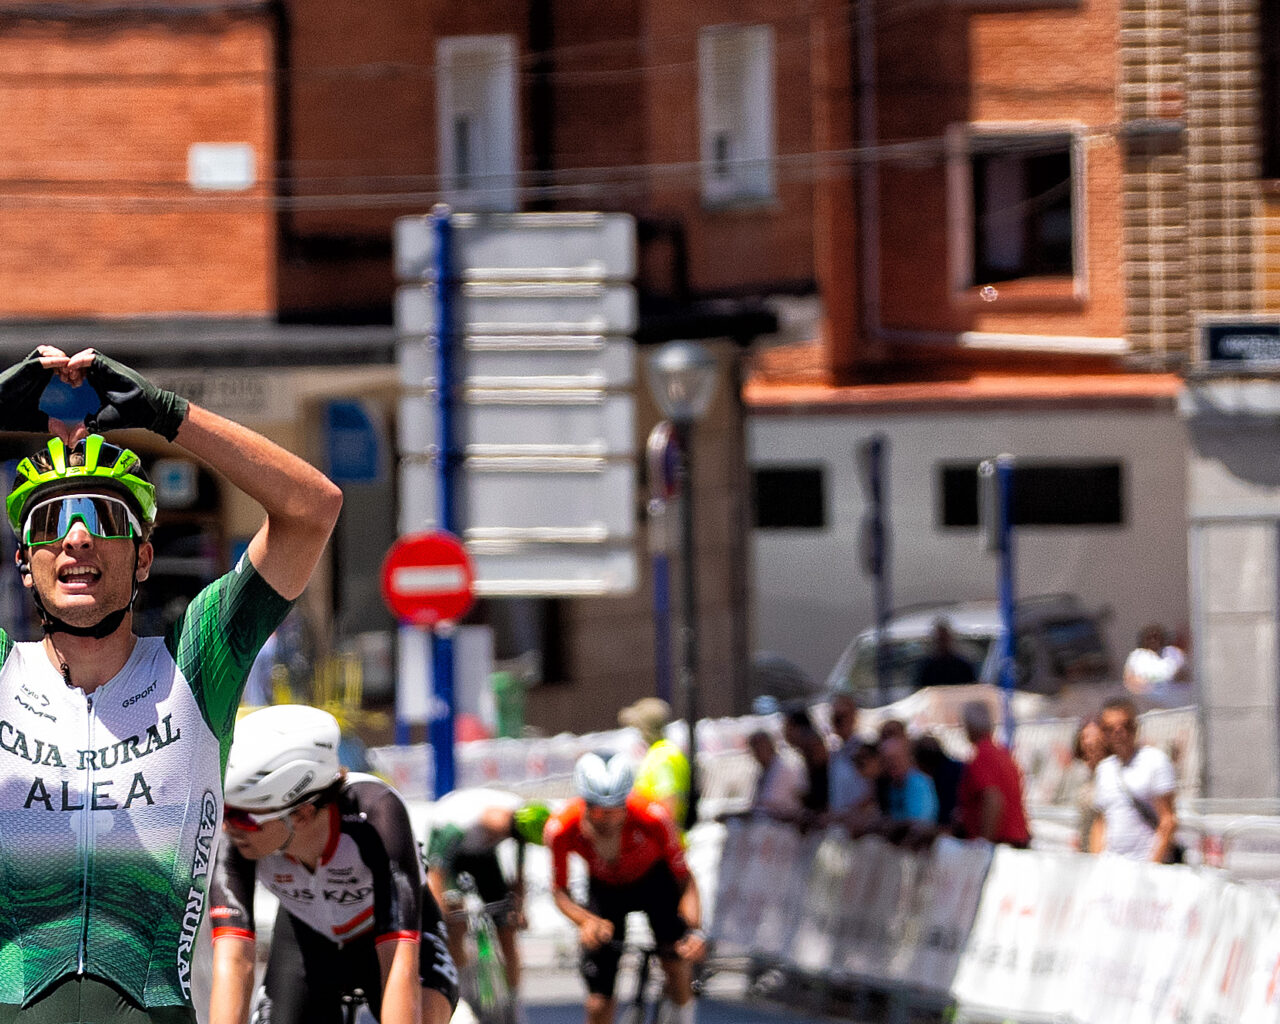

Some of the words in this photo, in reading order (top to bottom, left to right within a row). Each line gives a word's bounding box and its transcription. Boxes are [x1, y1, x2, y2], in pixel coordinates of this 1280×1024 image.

[122, 680, 158, 708] GSPORT
[76, 712, 181, 770] RURAL
[23, 772, 155, 812] ALEA
[177, 887, 205, 1000] RURAL
